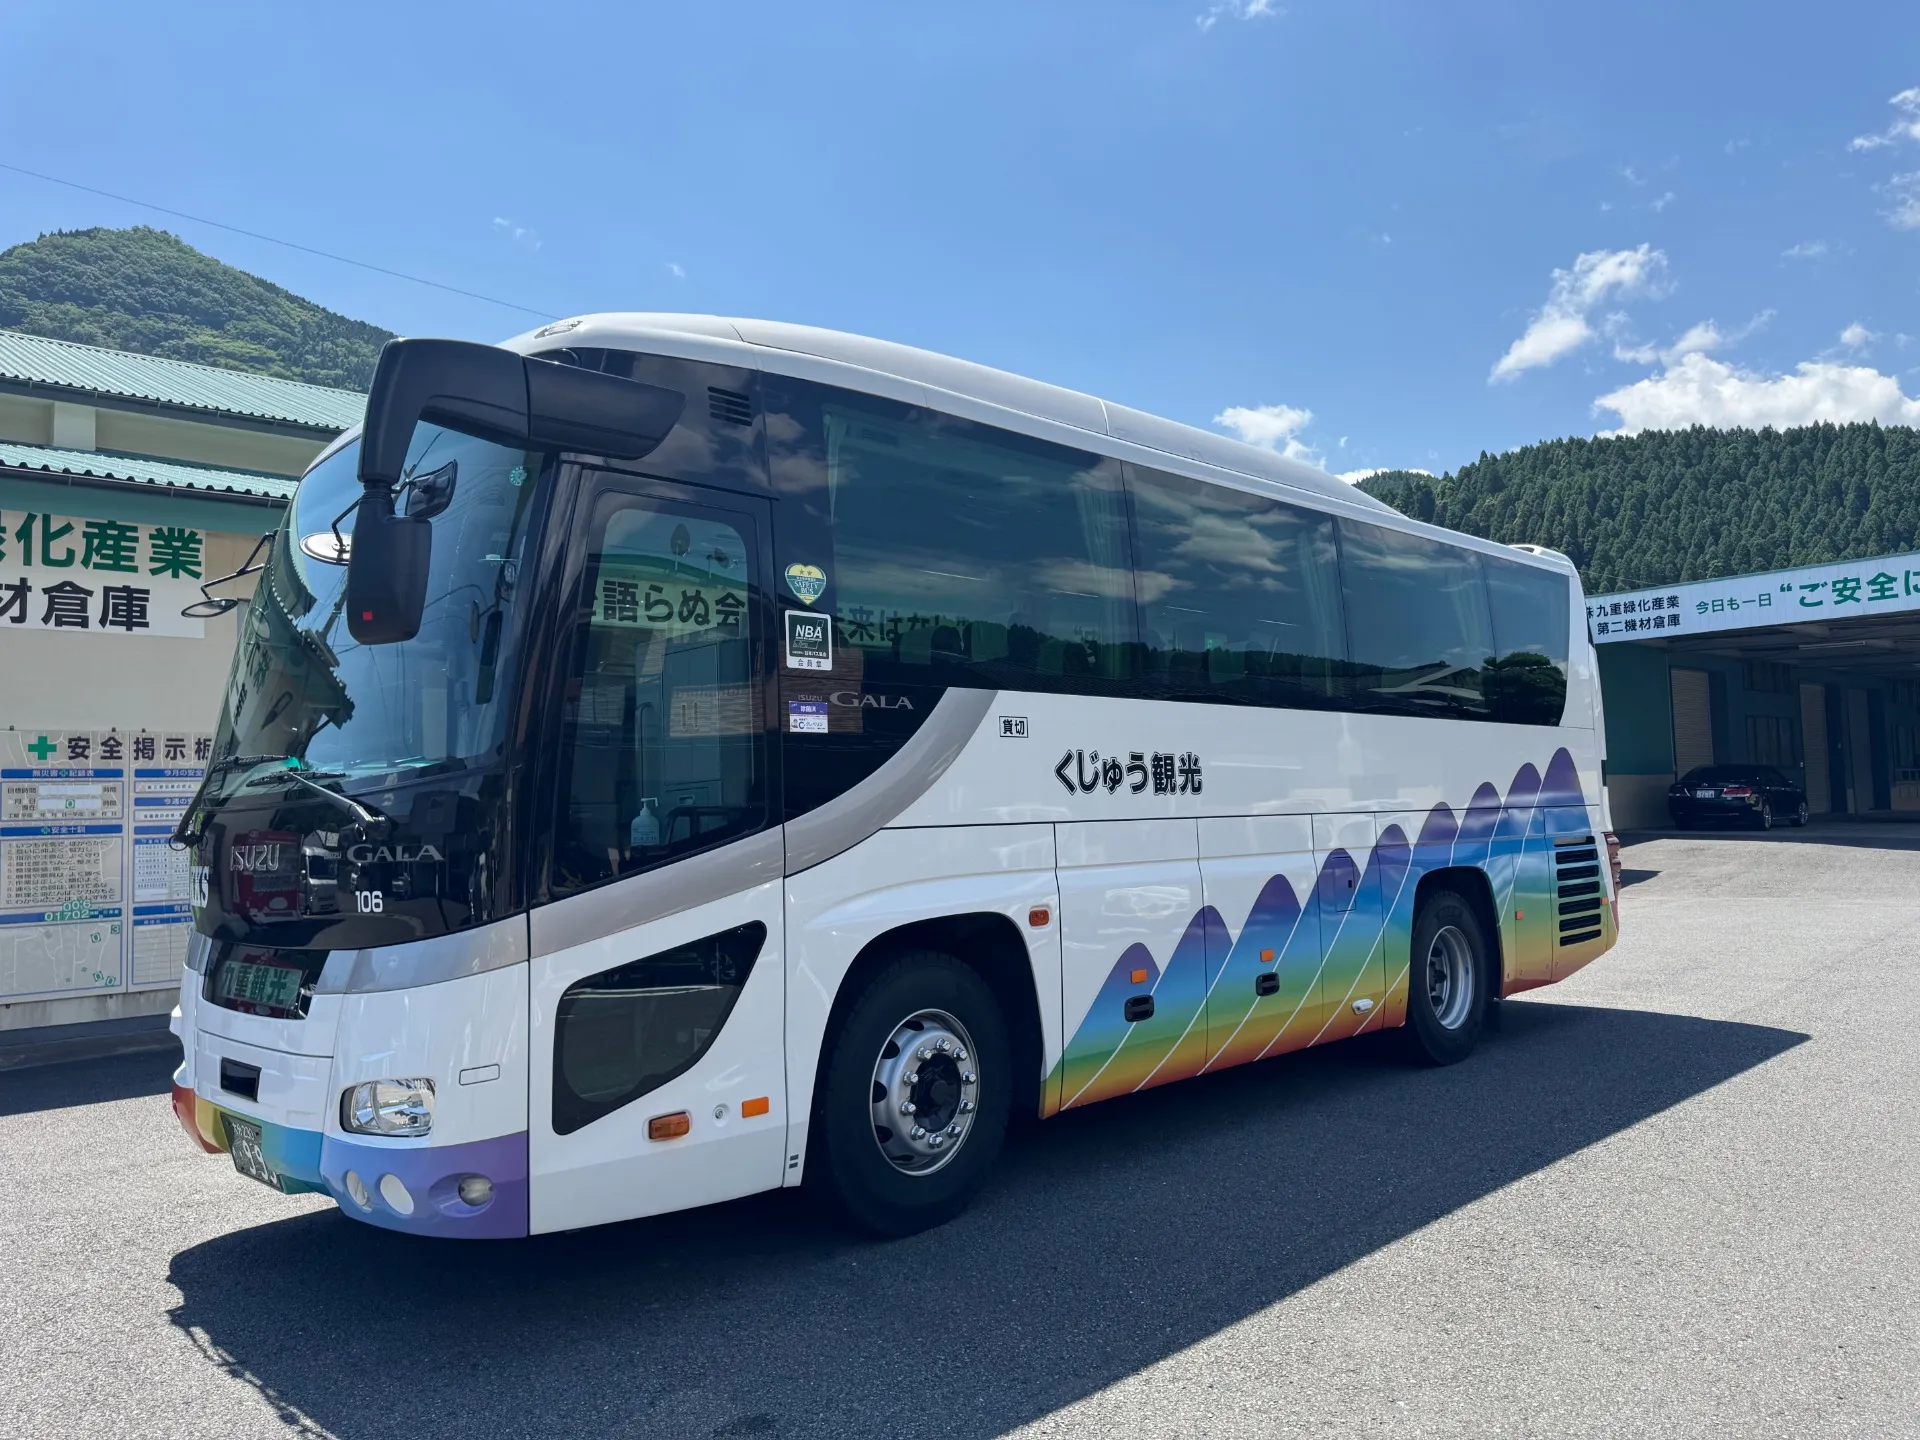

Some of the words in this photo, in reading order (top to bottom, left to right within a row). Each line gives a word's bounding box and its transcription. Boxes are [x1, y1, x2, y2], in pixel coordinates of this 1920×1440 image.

[794, 580, 819, 590] SAFETY
[591, 579, 746, 627] 語らぬ会
[1696, 593, 1772, 615] 今日も一日
[795, 624, 823, 639] NBA
[1597, 614, 1681, 636] 第二機材倉庫
[829, 691, 915, 710] GALA
[1003, 718, 1025, 735] 貸切
[1054, 749, 1203, 796] くじゅう観光
[230, 844, 280, 871] ISUZU
[347, 844, 444, 863] GALA
[355, 890, 384, 913] 106
[222, 962, 290, 1005] 九重観光
